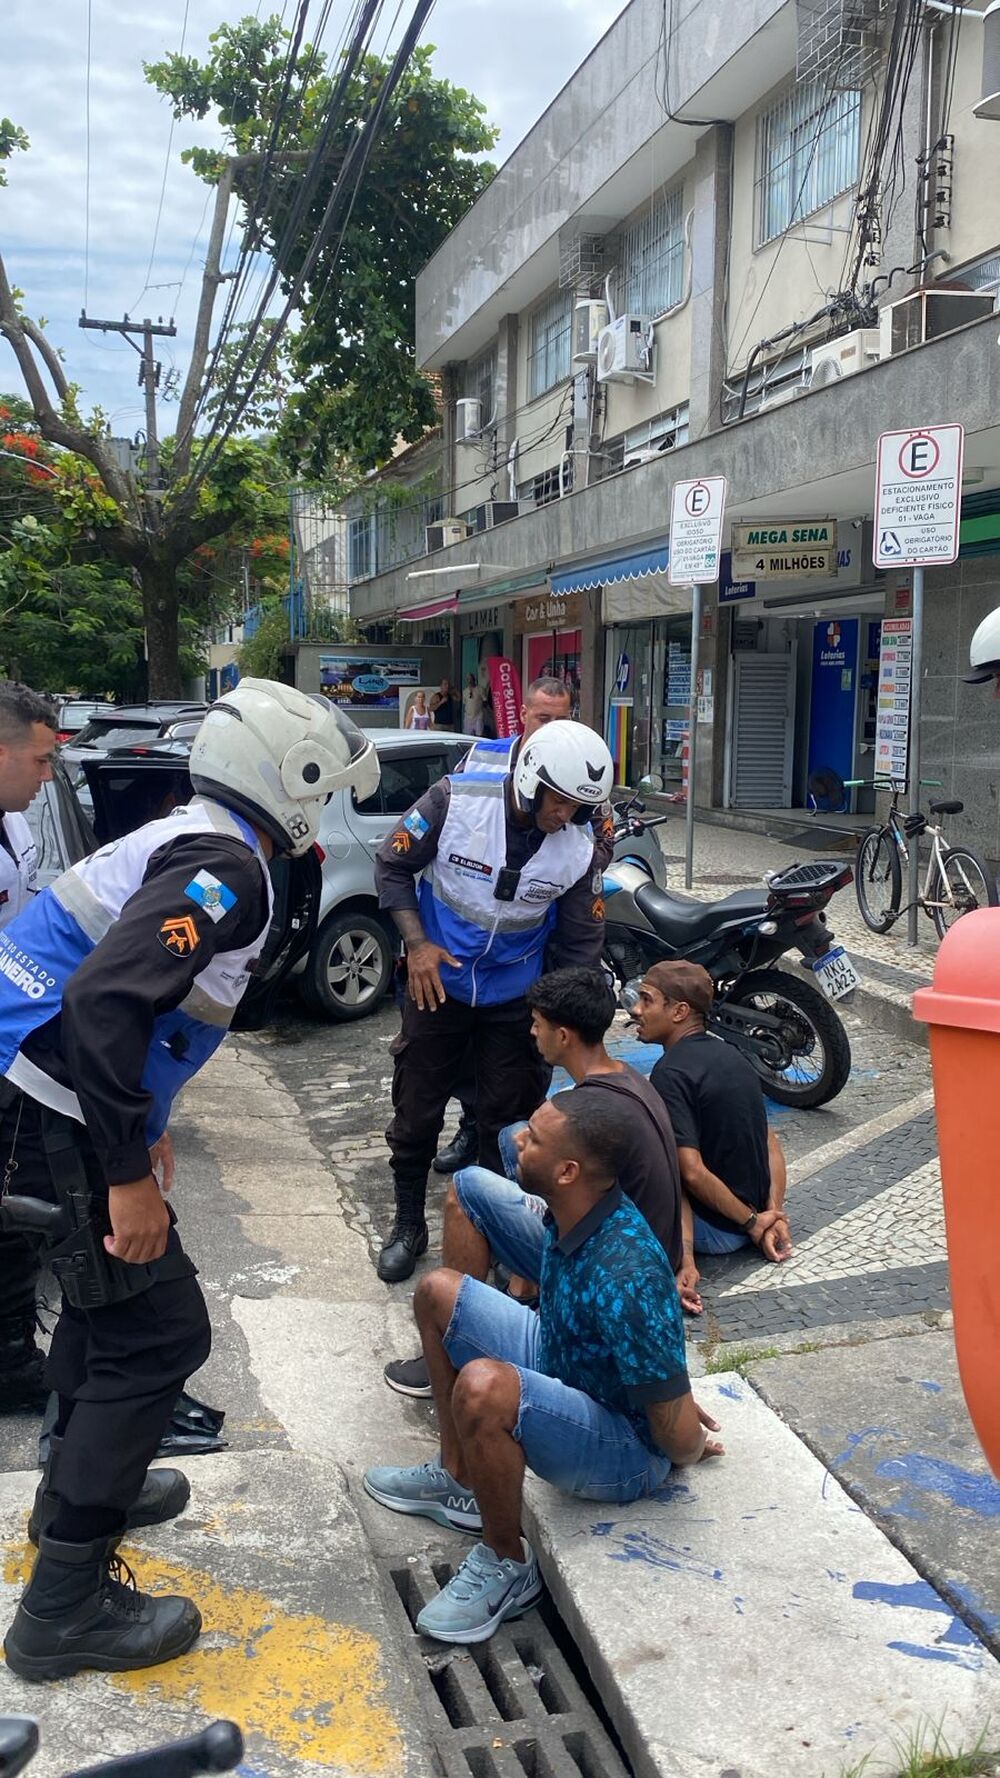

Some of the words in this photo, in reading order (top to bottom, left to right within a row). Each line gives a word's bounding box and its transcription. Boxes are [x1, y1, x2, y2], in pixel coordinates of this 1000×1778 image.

[911, 441, 928, 472] E
[882, 482, 954, 496] ESTACIONAMENTO
[692, 489, 704, 512] E
[896, 493, 940, 504] EXCLUSIVO
[881, 504, 926, 515] DEFICIENTE
[913, 513, 935, 521] VAGA
[747, 530, 787, 545] MEGA
[791, 527, 828, 543] SENA
[755, 558, 765, 571] 4
[769, 554, 825, 571] MILHÕES
[525, 605, 538, 621] Cor
[540, 601, 546, 619] &
[546, 599, 566, 618] Unha
[820, 649, 845, 660] Loterias
[15, 951, 56, 987] ESTADO
[828, 969, 856, 996] 2A23
